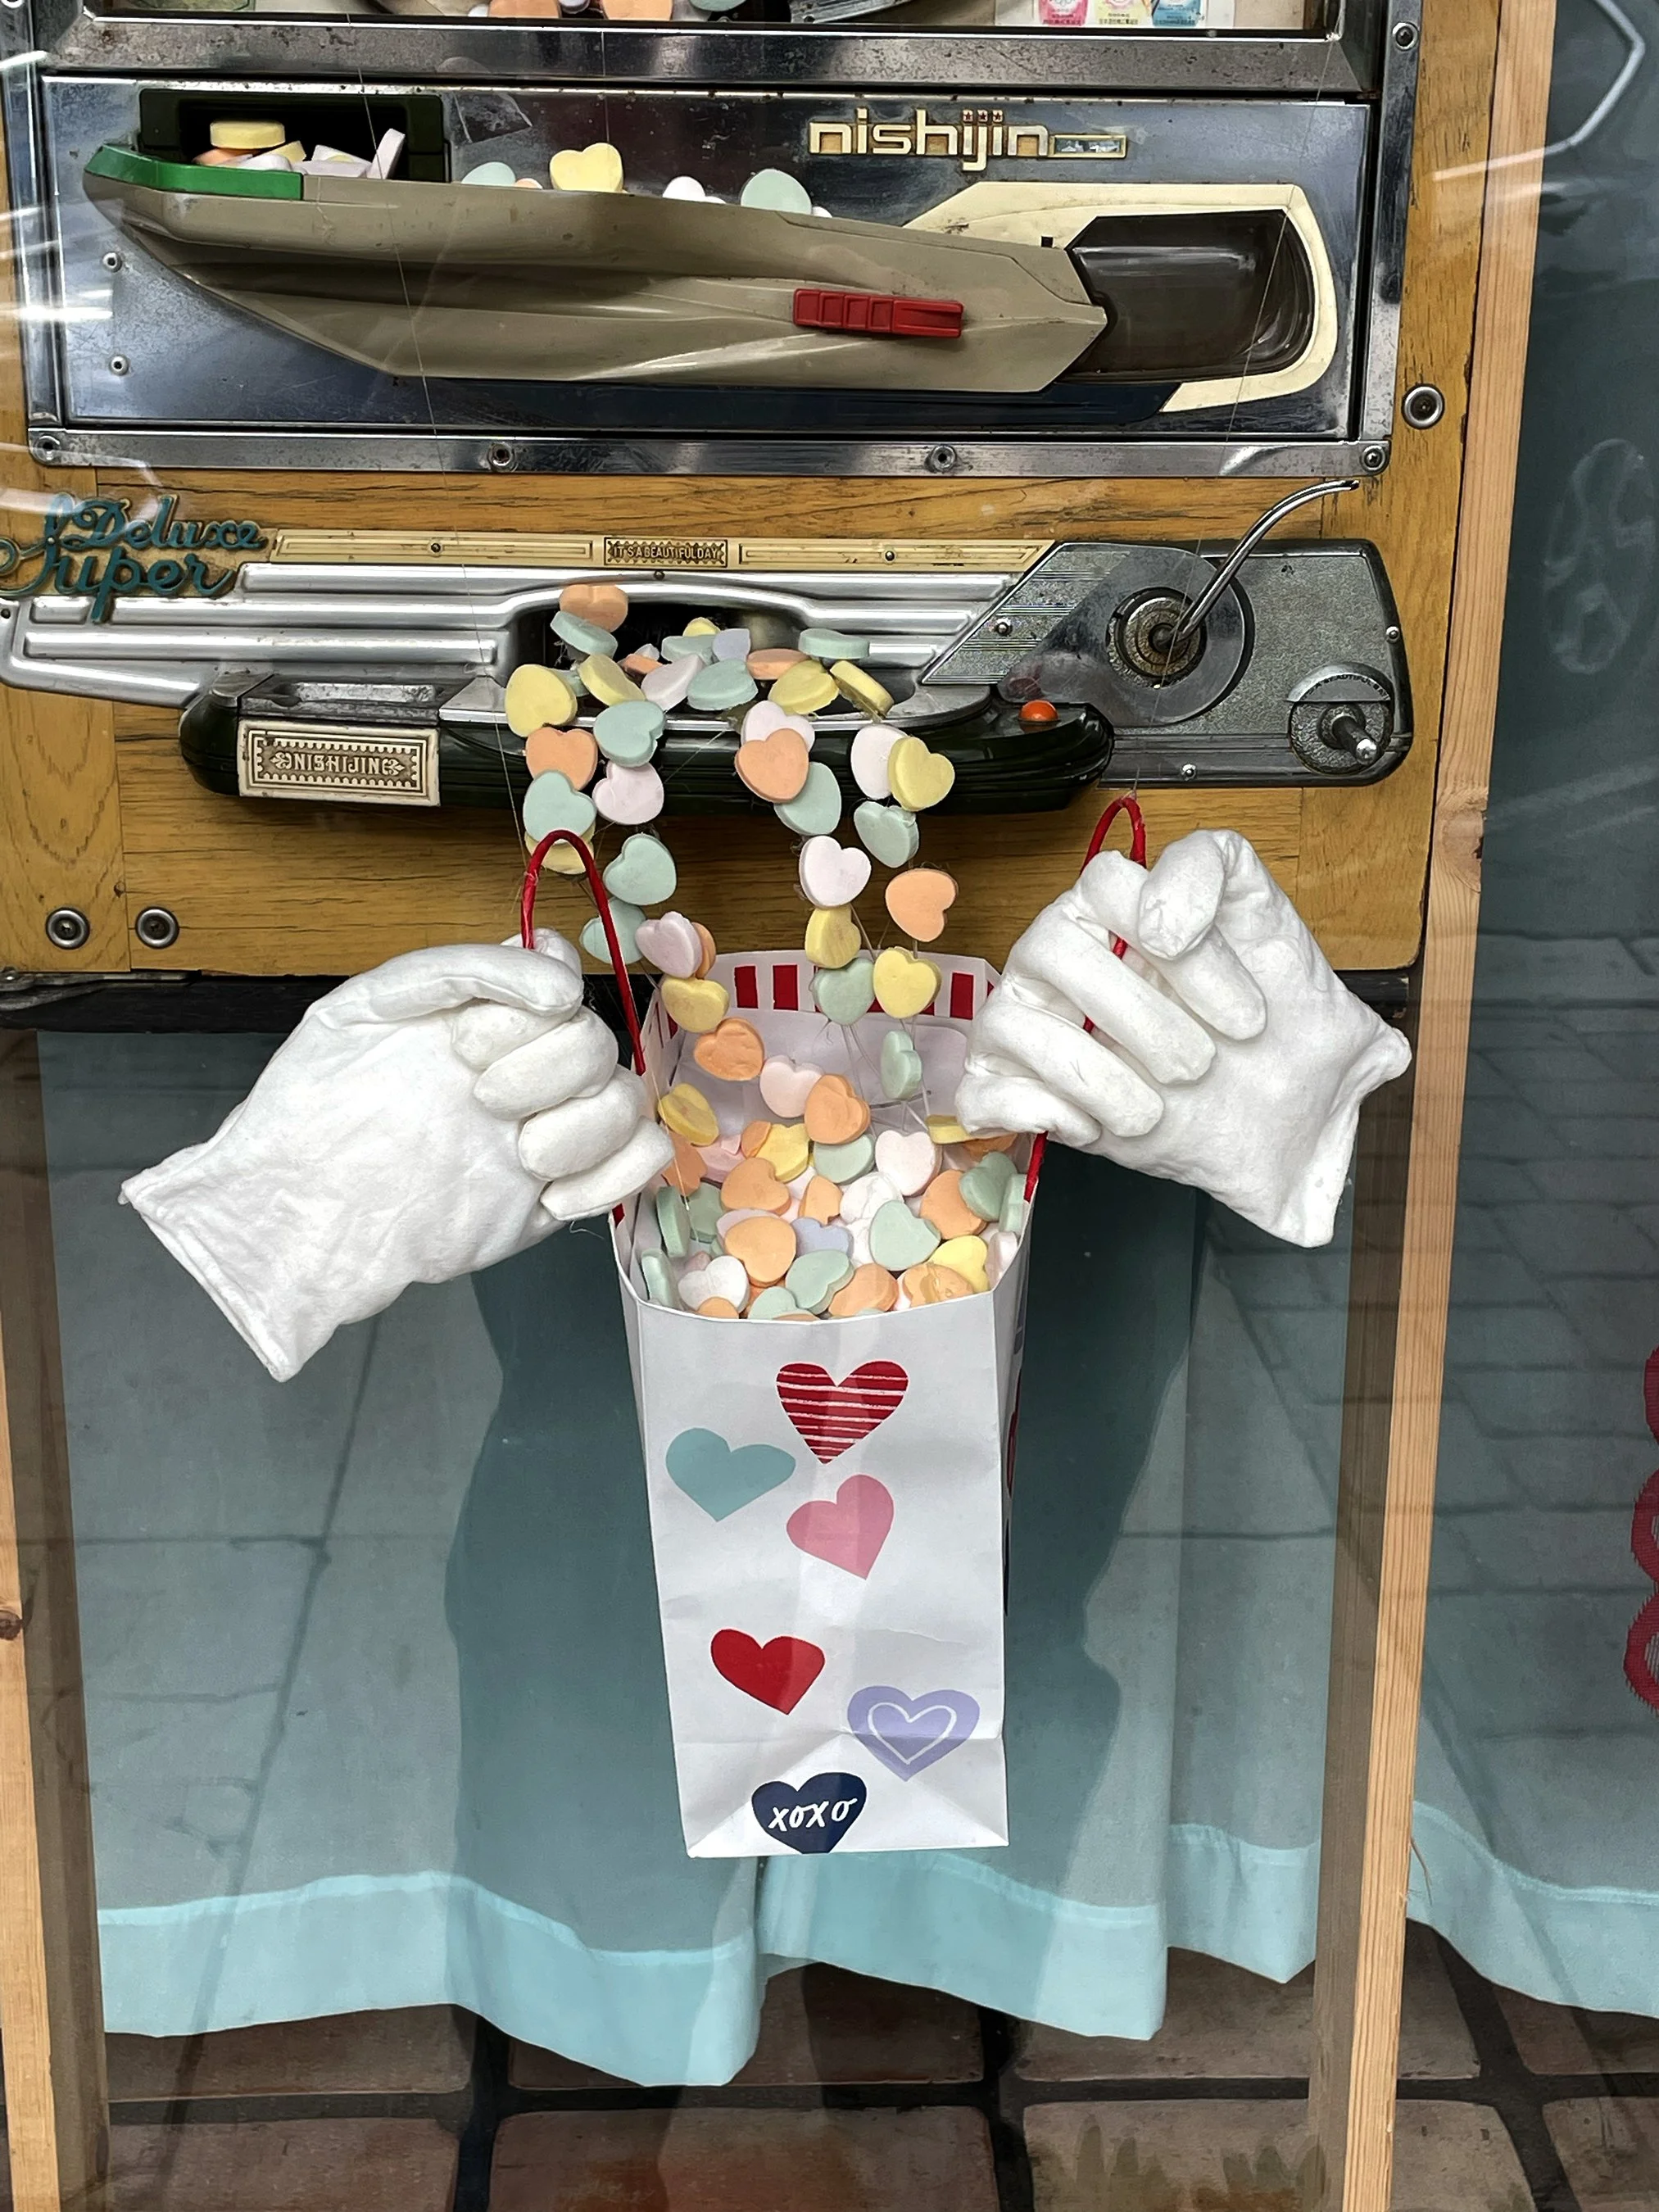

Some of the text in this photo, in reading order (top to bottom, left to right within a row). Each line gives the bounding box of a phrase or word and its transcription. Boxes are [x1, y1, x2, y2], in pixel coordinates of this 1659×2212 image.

[809, 107, 1049, 172] nishijin
[61, 494, 269, 551] Deluxe
[292, 751, 383, 775] NISHIJIN
